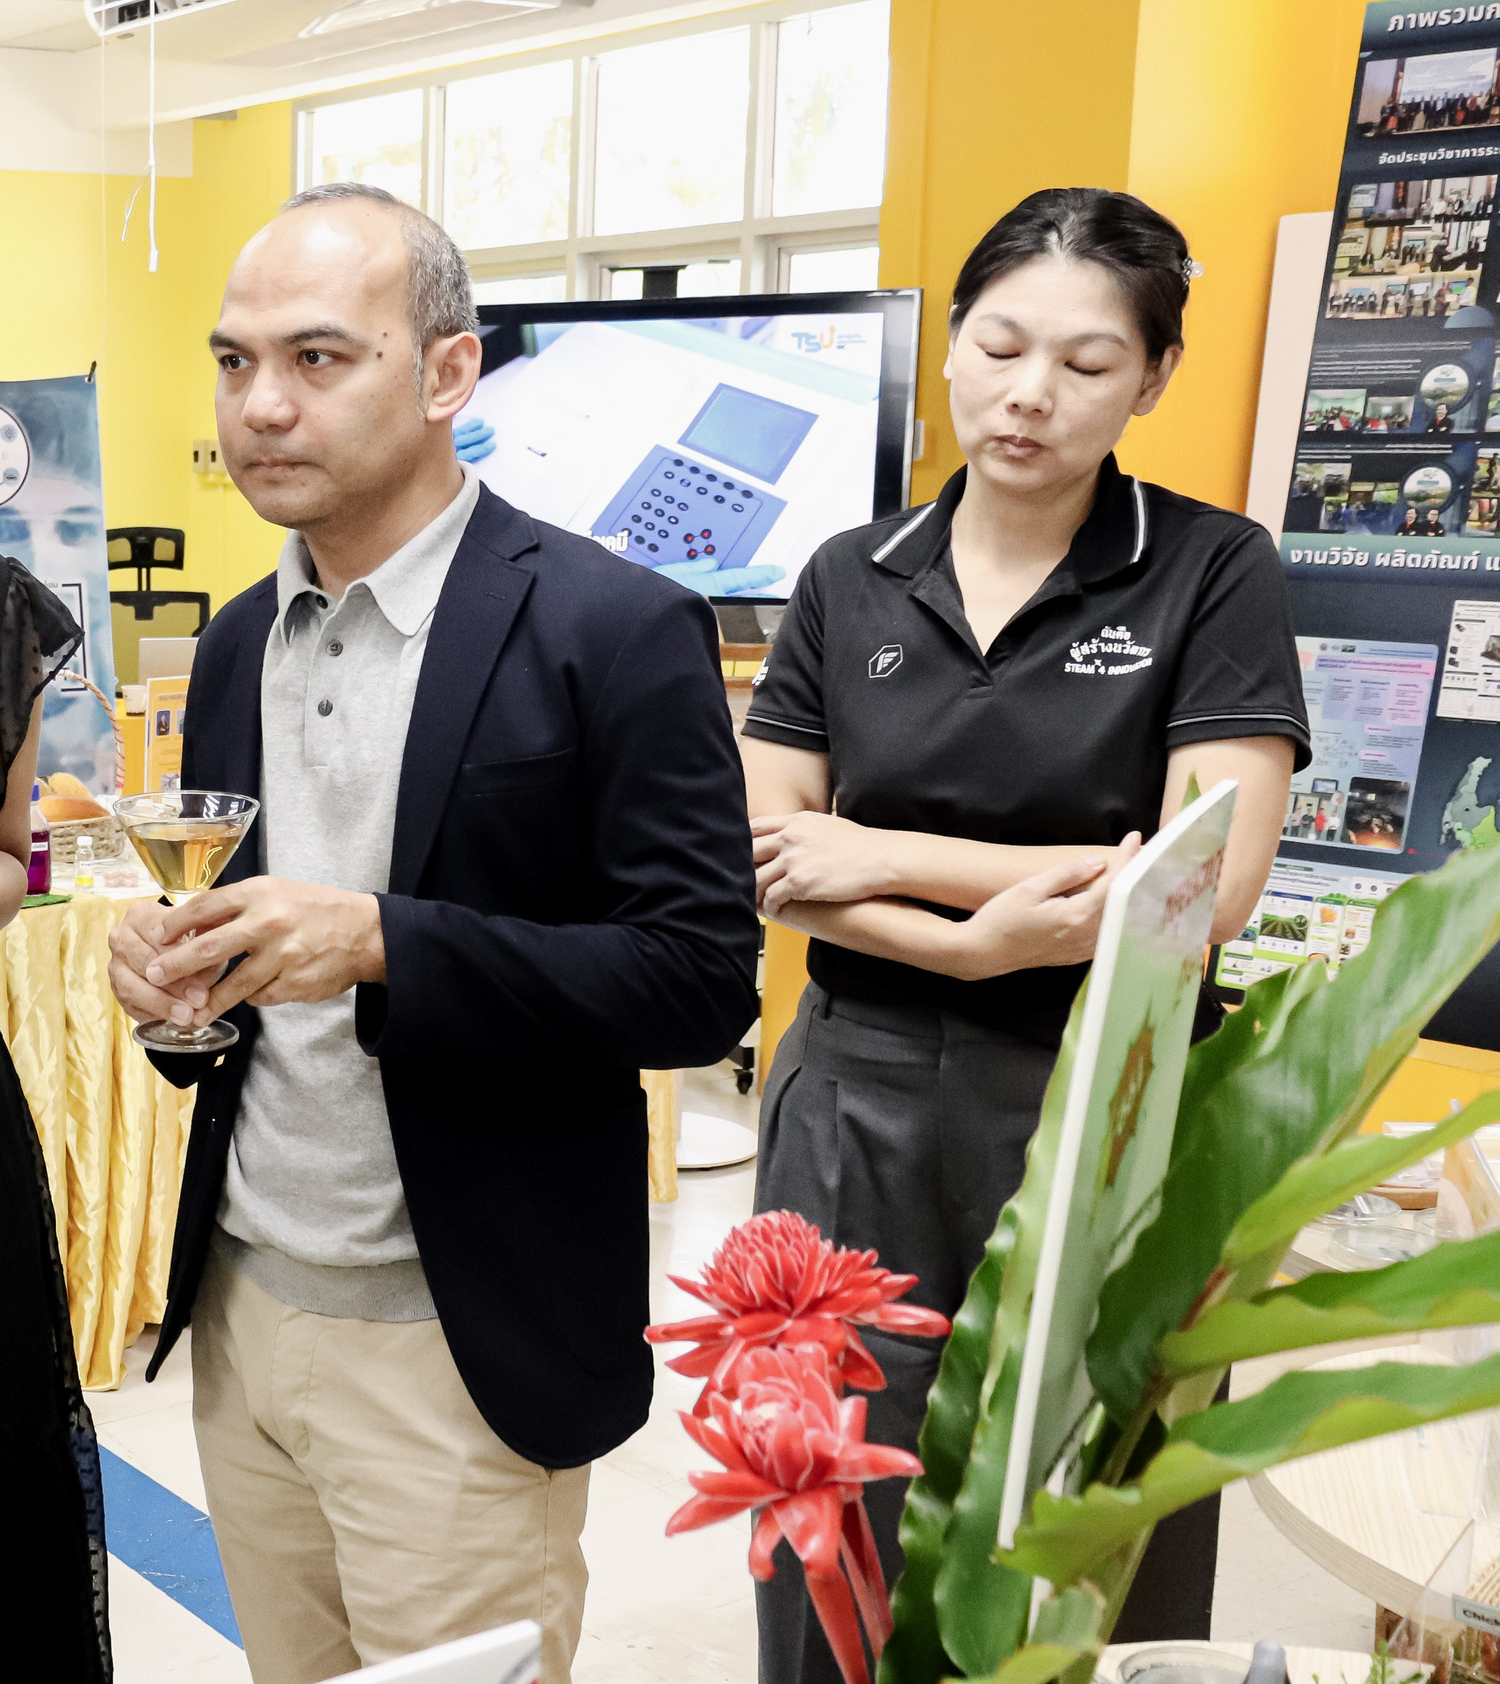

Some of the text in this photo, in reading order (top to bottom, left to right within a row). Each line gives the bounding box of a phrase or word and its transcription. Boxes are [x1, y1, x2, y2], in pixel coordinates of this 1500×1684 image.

[1378, 146, 1500, 165] จัดประชุมวิชาการระ
[791, 324, 835, 353] TSU
[1290, 547, 1370, 567] งานวิจัย
[1375, 548, 1481, 571] ผลิตภัณฑ์
[1064, 662, 1096, 675] STEAM
[1097, 665, 1106, 675] 4
